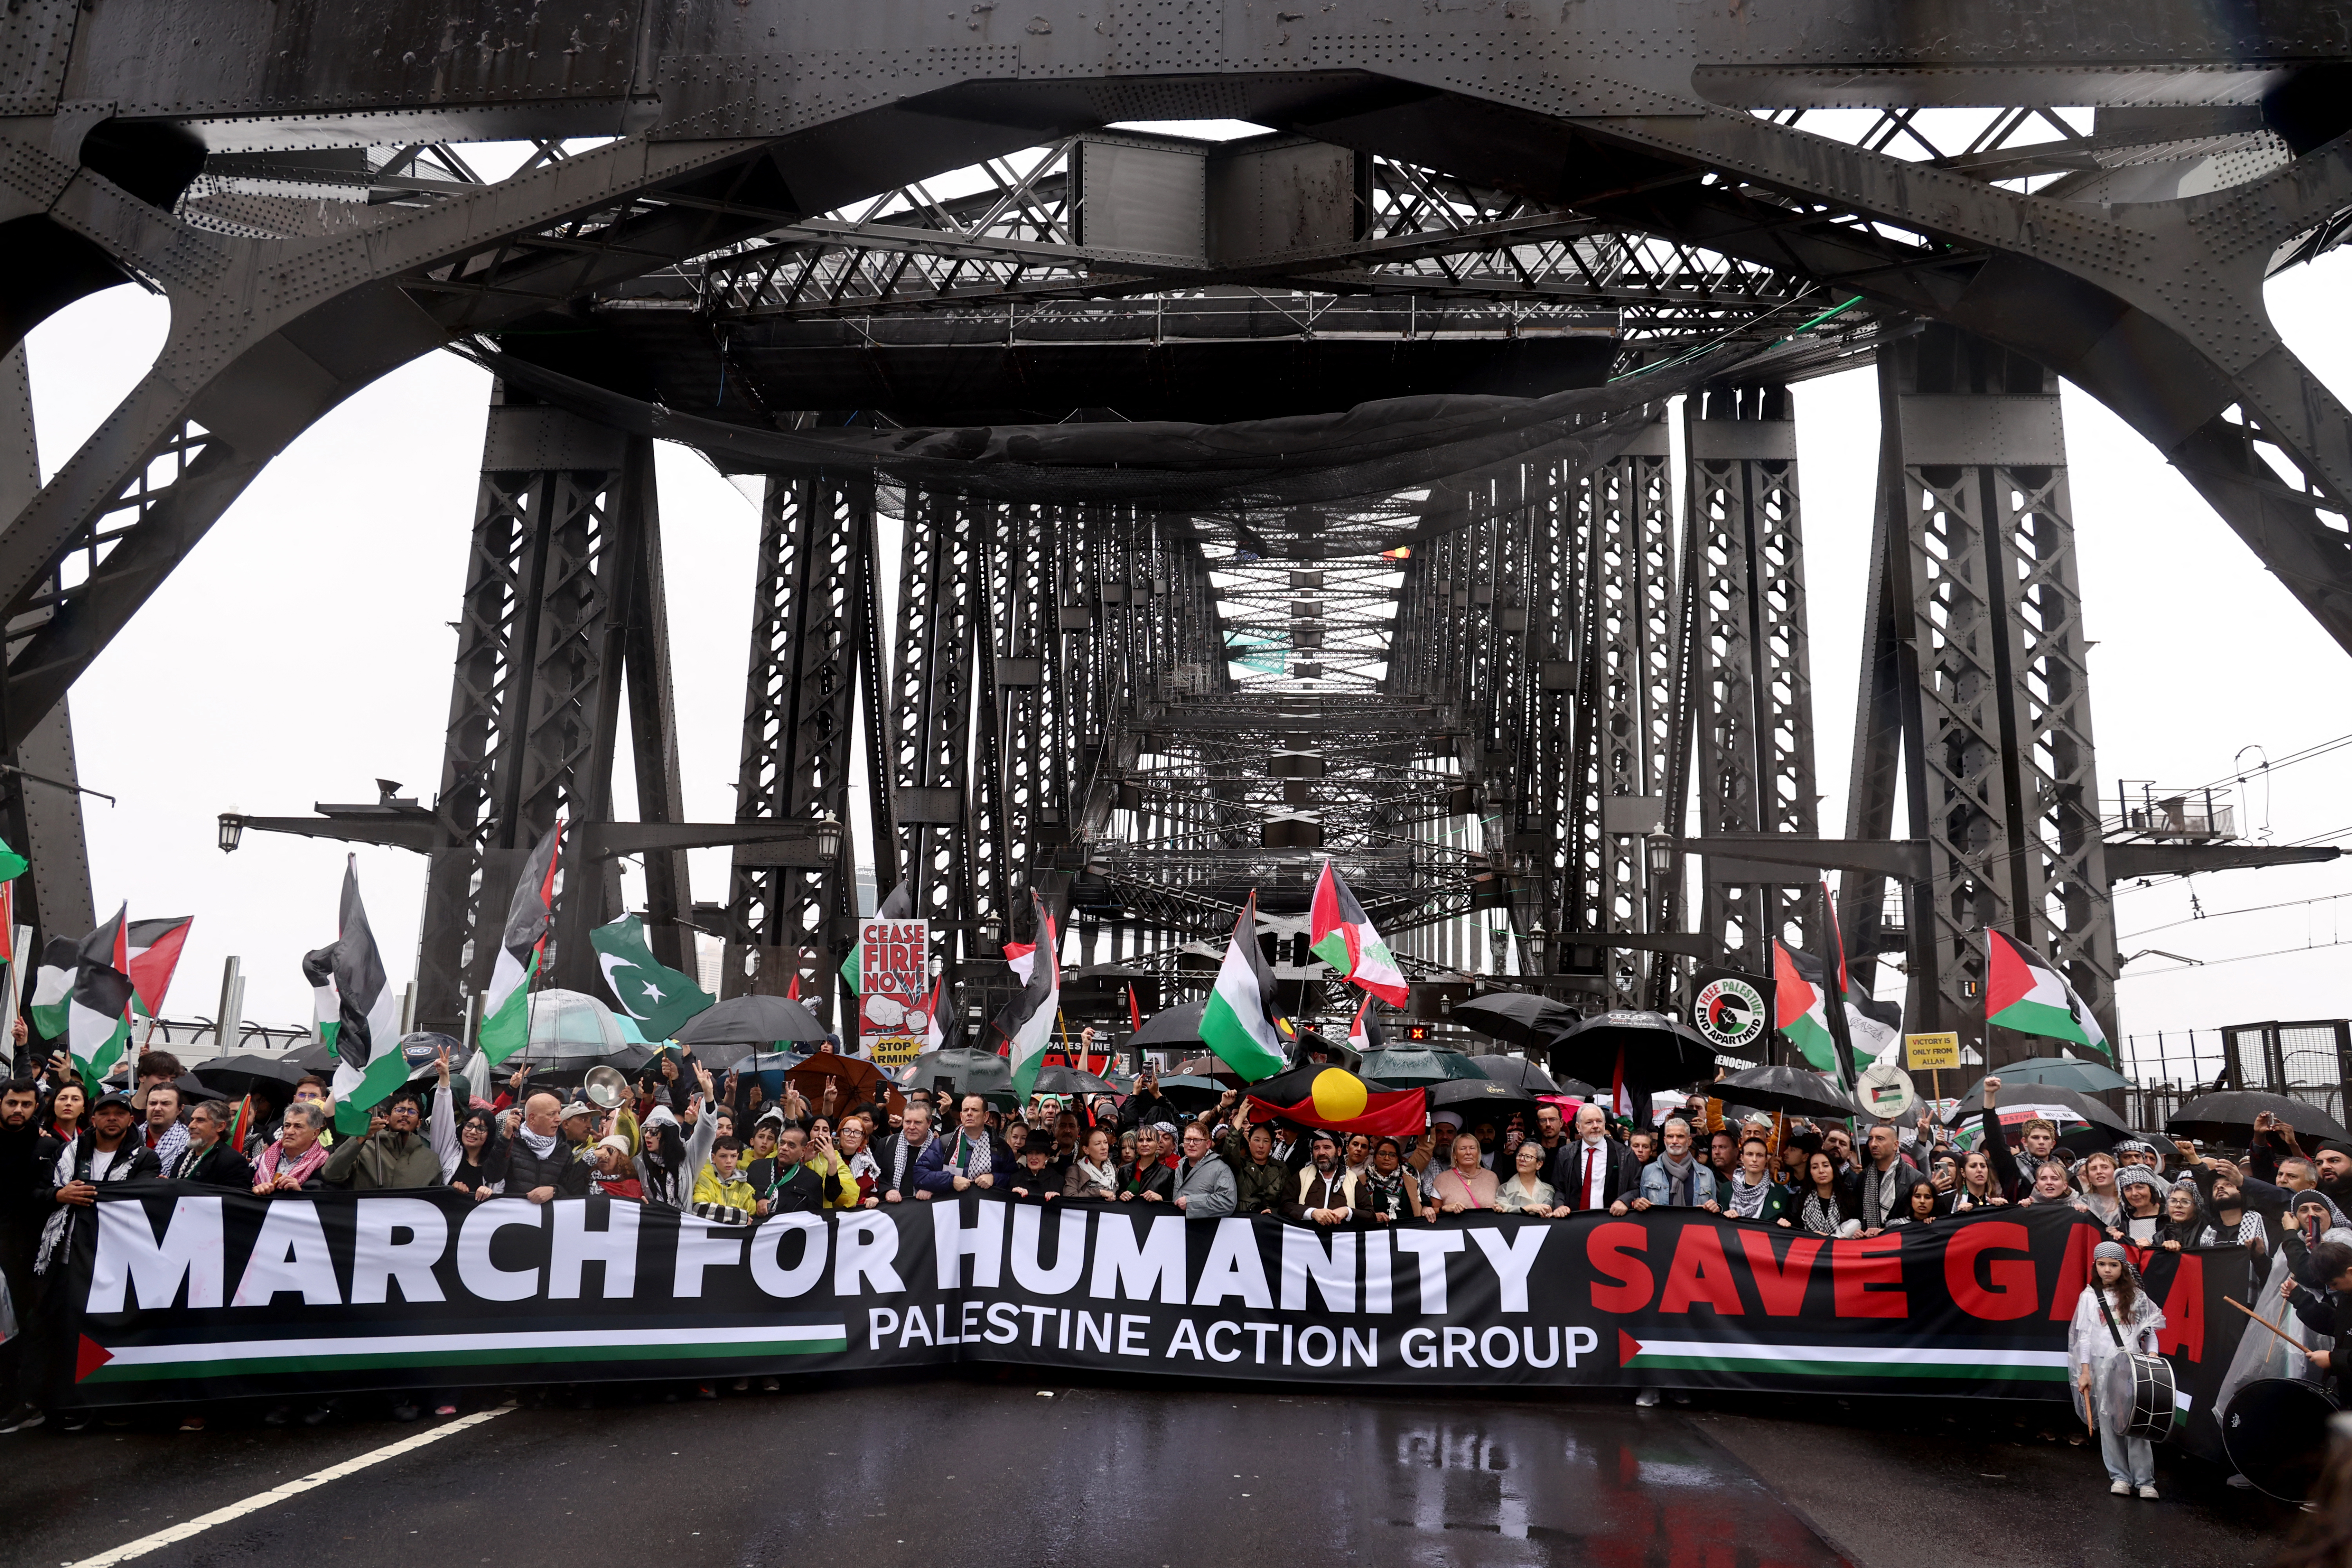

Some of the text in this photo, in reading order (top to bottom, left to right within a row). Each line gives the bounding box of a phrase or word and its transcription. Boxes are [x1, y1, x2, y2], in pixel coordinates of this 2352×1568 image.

[864, 925, 924, 944] CEASE
[864, 944, 924, 971] FIRE
[864, 972, 925, 992] NOW!
[1699, 981, 1763, 1017] FREE PALESTINE
[1697, 1007, 1761, 1045] END APARTHEID
[1849, 1017, 1885, 1042] GAZA
[878, 1042, 911, 1051] STOP
[1047, 1042, 1110, 1051] PAESINE
[86, 1196, 2205, 1363] MARCH FOR HUMANITY SAVE GAA
[869, 1301, 1598, 1368] PALESTINE ACTION GROUP
